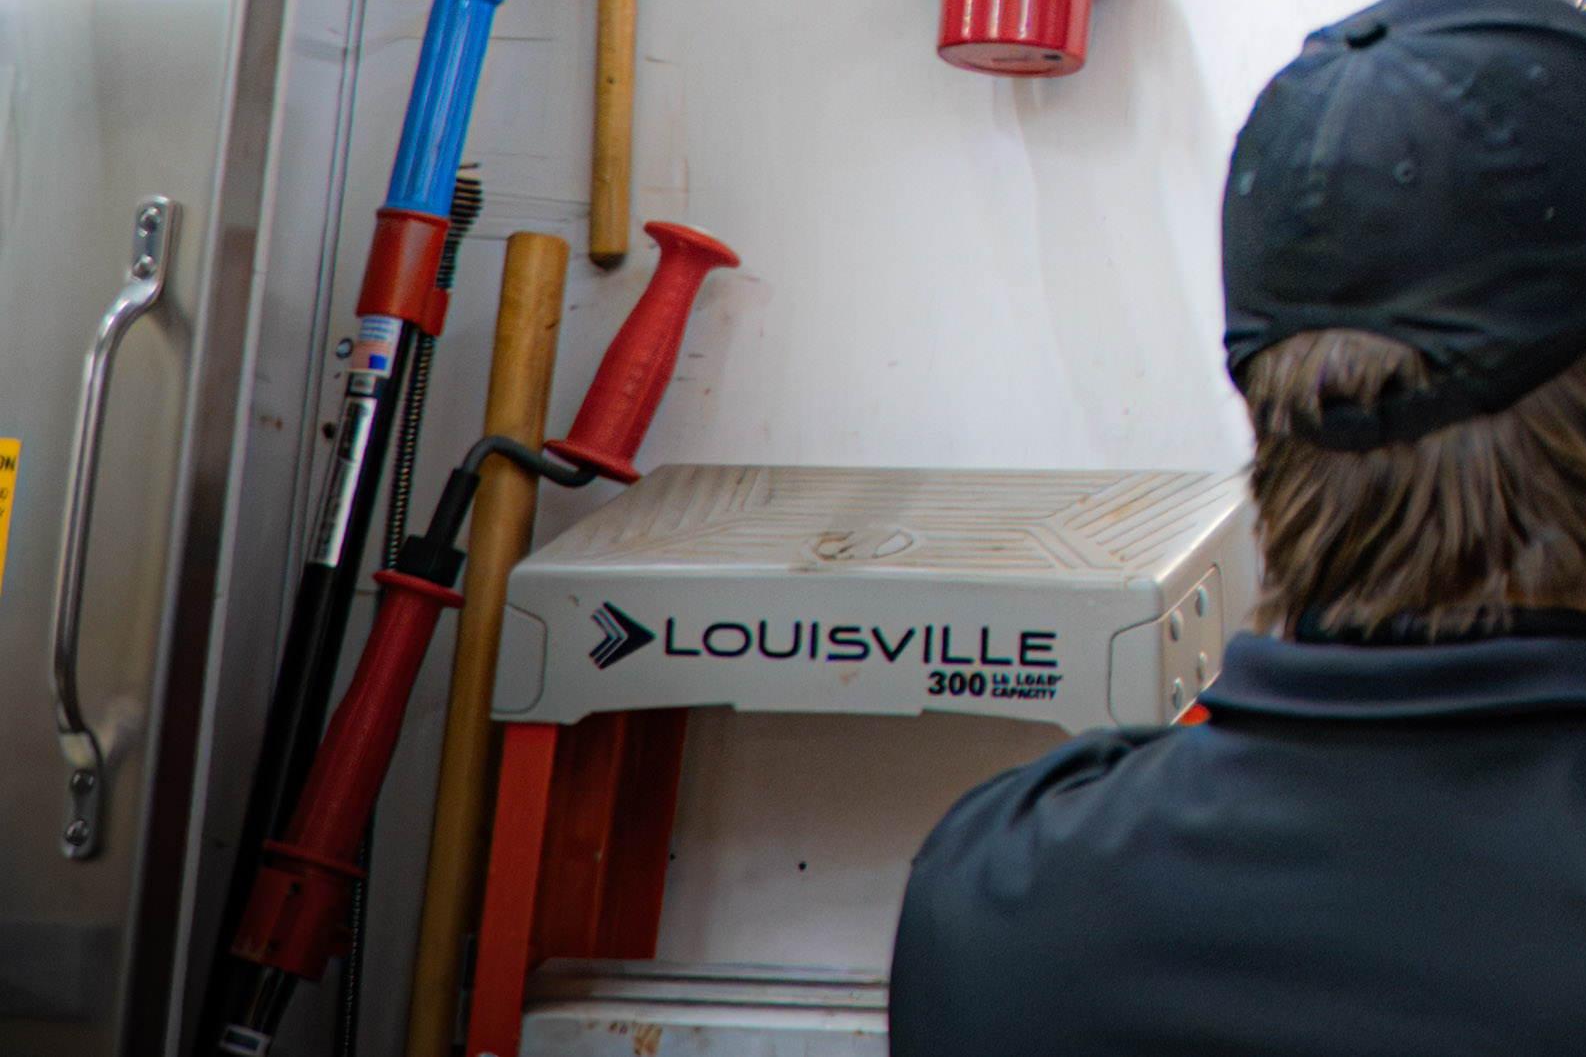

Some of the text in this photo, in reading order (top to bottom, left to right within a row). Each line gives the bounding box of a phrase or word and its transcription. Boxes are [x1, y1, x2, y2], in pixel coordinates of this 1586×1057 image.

[665, 616, 1058, 667] LOUISVILLE
[927, 670, 987, 697] 300
[990, 686, 1057, 700] CAPACITY
